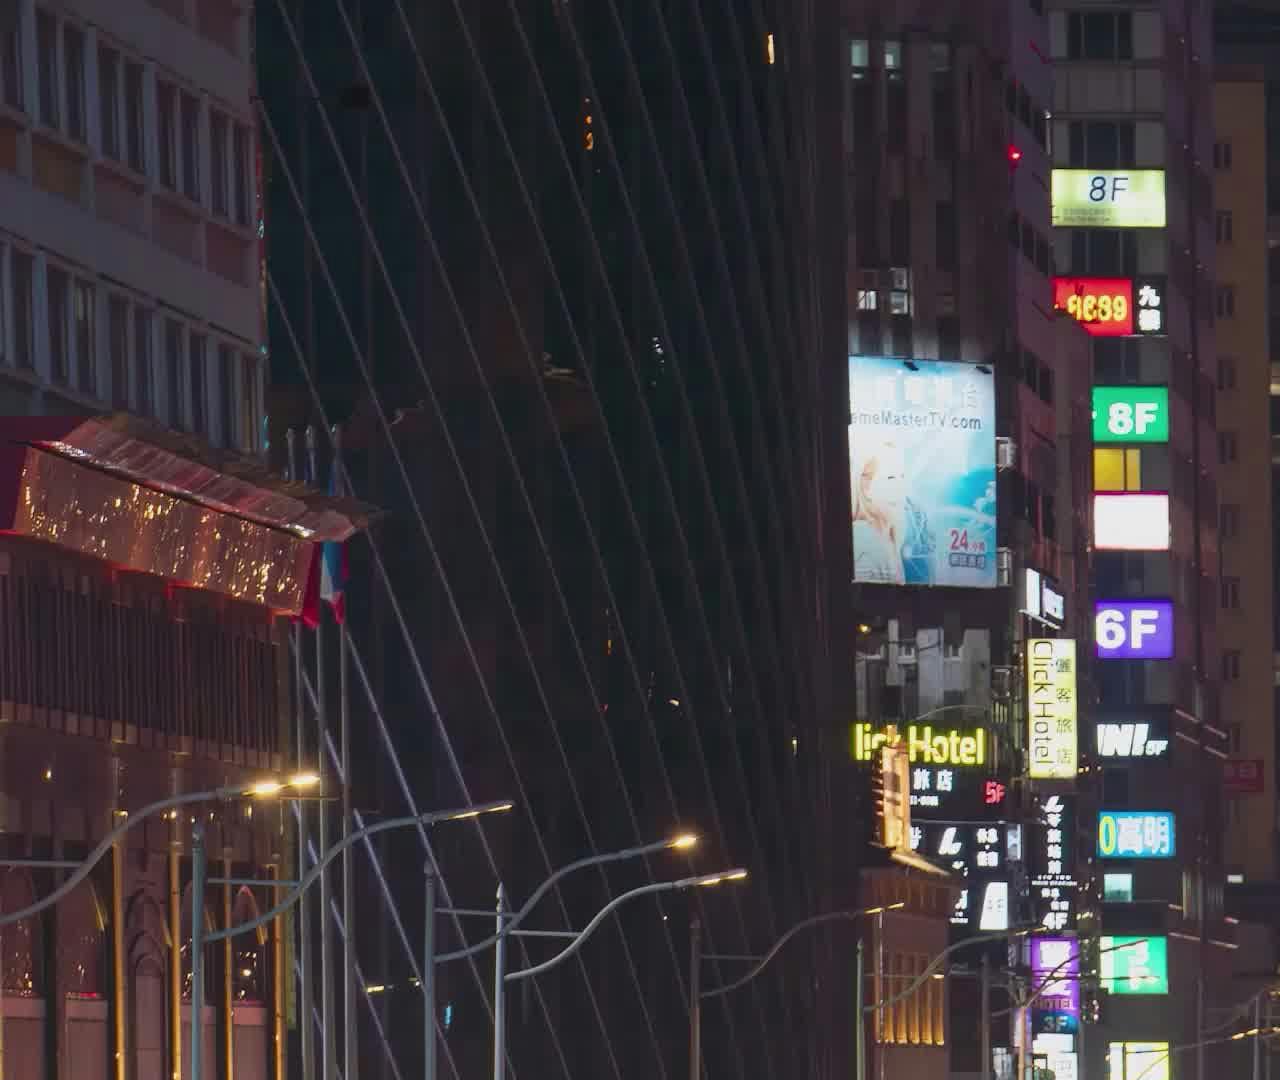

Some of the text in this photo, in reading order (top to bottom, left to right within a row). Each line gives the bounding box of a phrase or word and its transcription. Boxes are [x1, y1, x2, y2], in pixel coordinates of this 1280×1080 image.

[1089, 176, 1129, 202] 8F
[1107, 403, 1159, 434] 8F
[951, 529, 968, 551] 24
[1096, 609, 1160, 650] 6F
[1034, 641, 1055, 764] Click Hotel
[909, 725, 984, 765] Hotel
